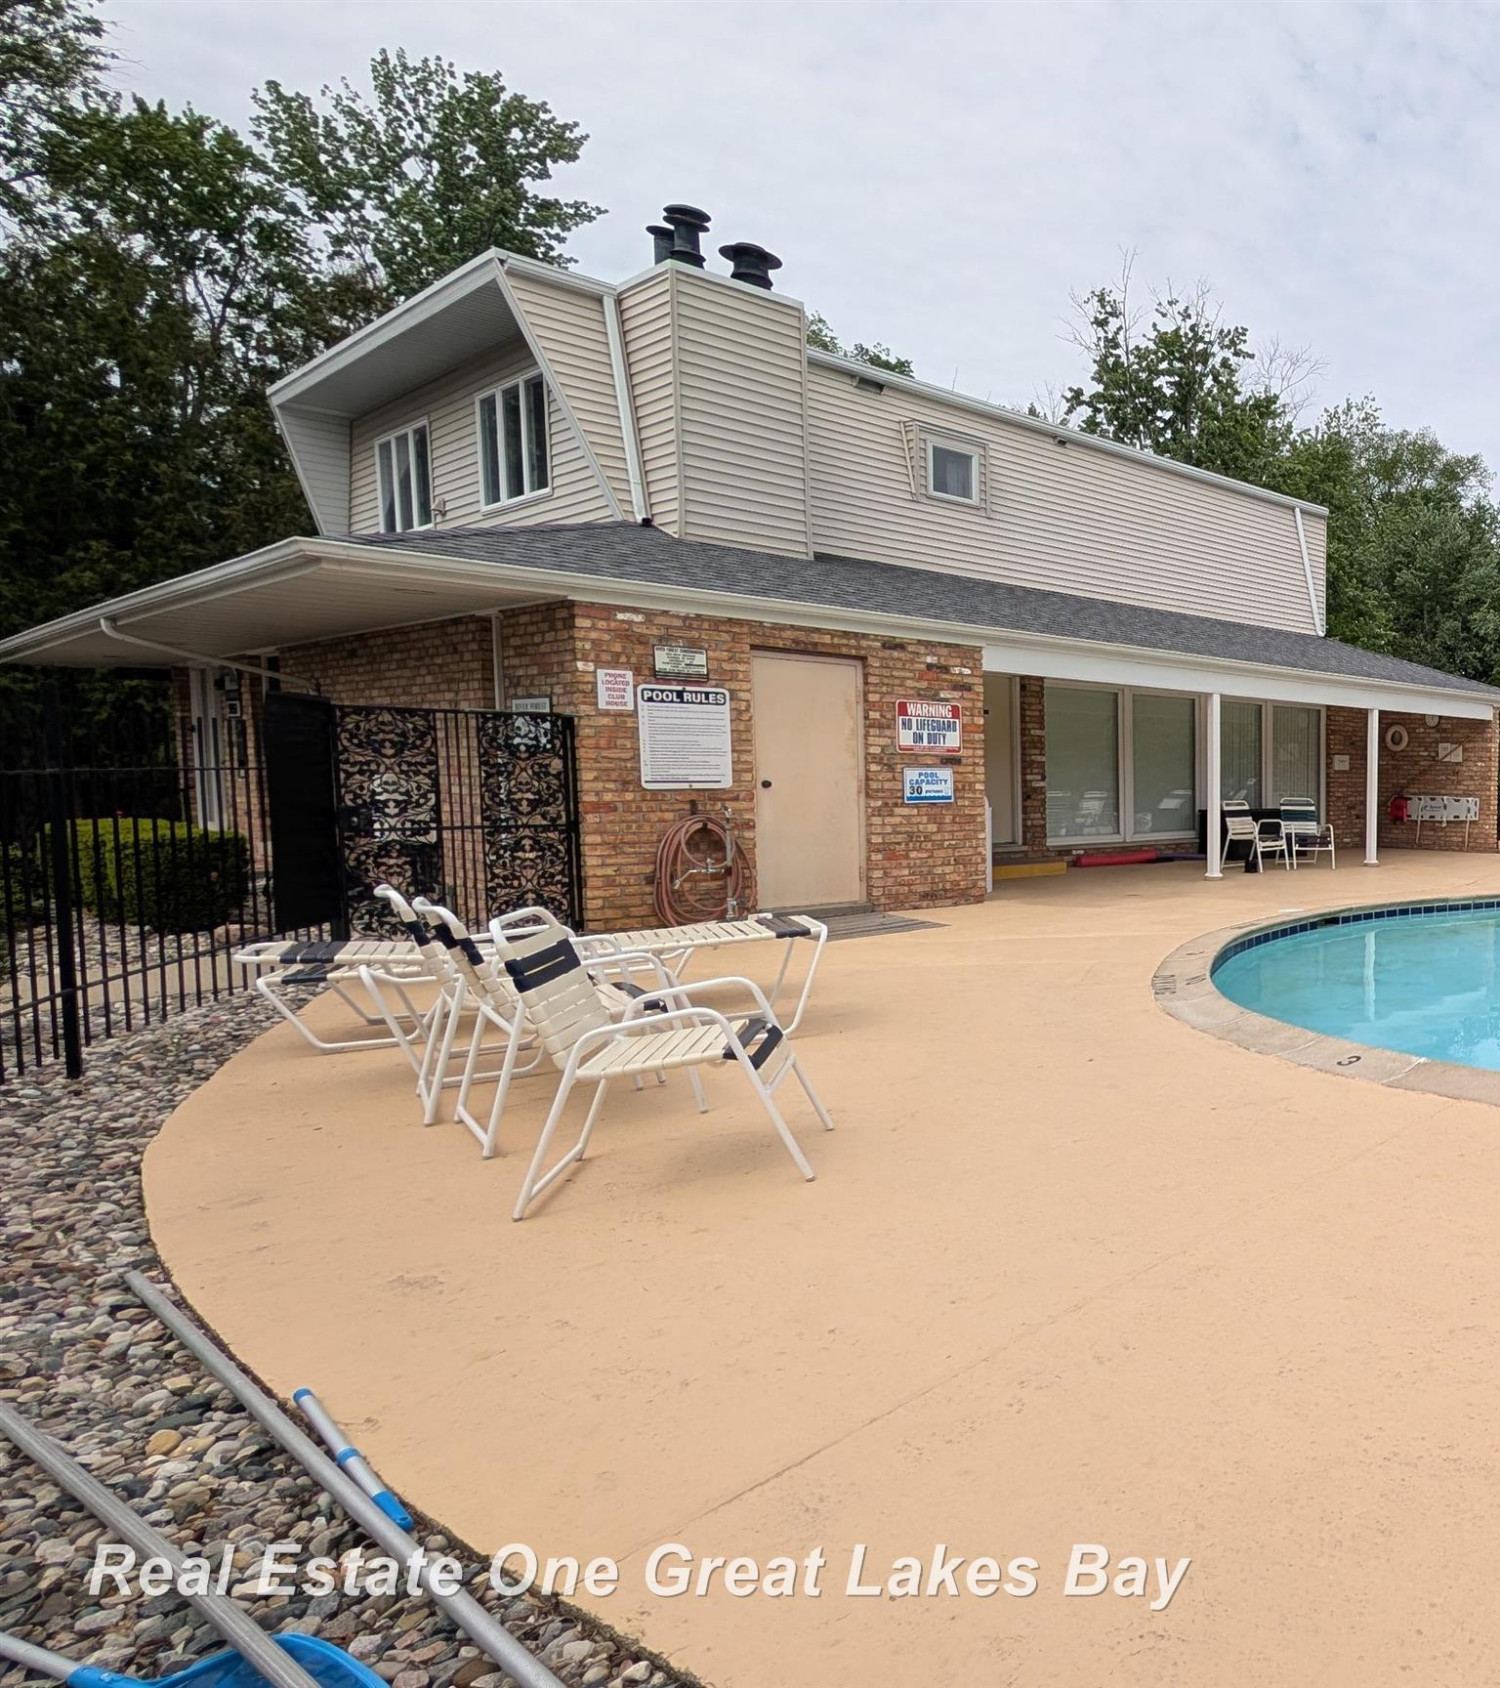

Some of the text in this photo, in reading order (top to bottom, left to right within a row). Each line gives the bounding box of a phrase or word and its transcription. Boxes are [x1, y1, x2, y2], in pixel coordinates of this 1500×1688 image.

[643, 690, 725, 704] POOL RULES
[906, 703, 952, 718] WARNING
[901, 718, 957, 732] NO LIFEGUARD
[912, 732, 947, 745] ON DUTY
[909, 786, 923, 795] 30
[1336, 1055, 1362, 1067] 3
